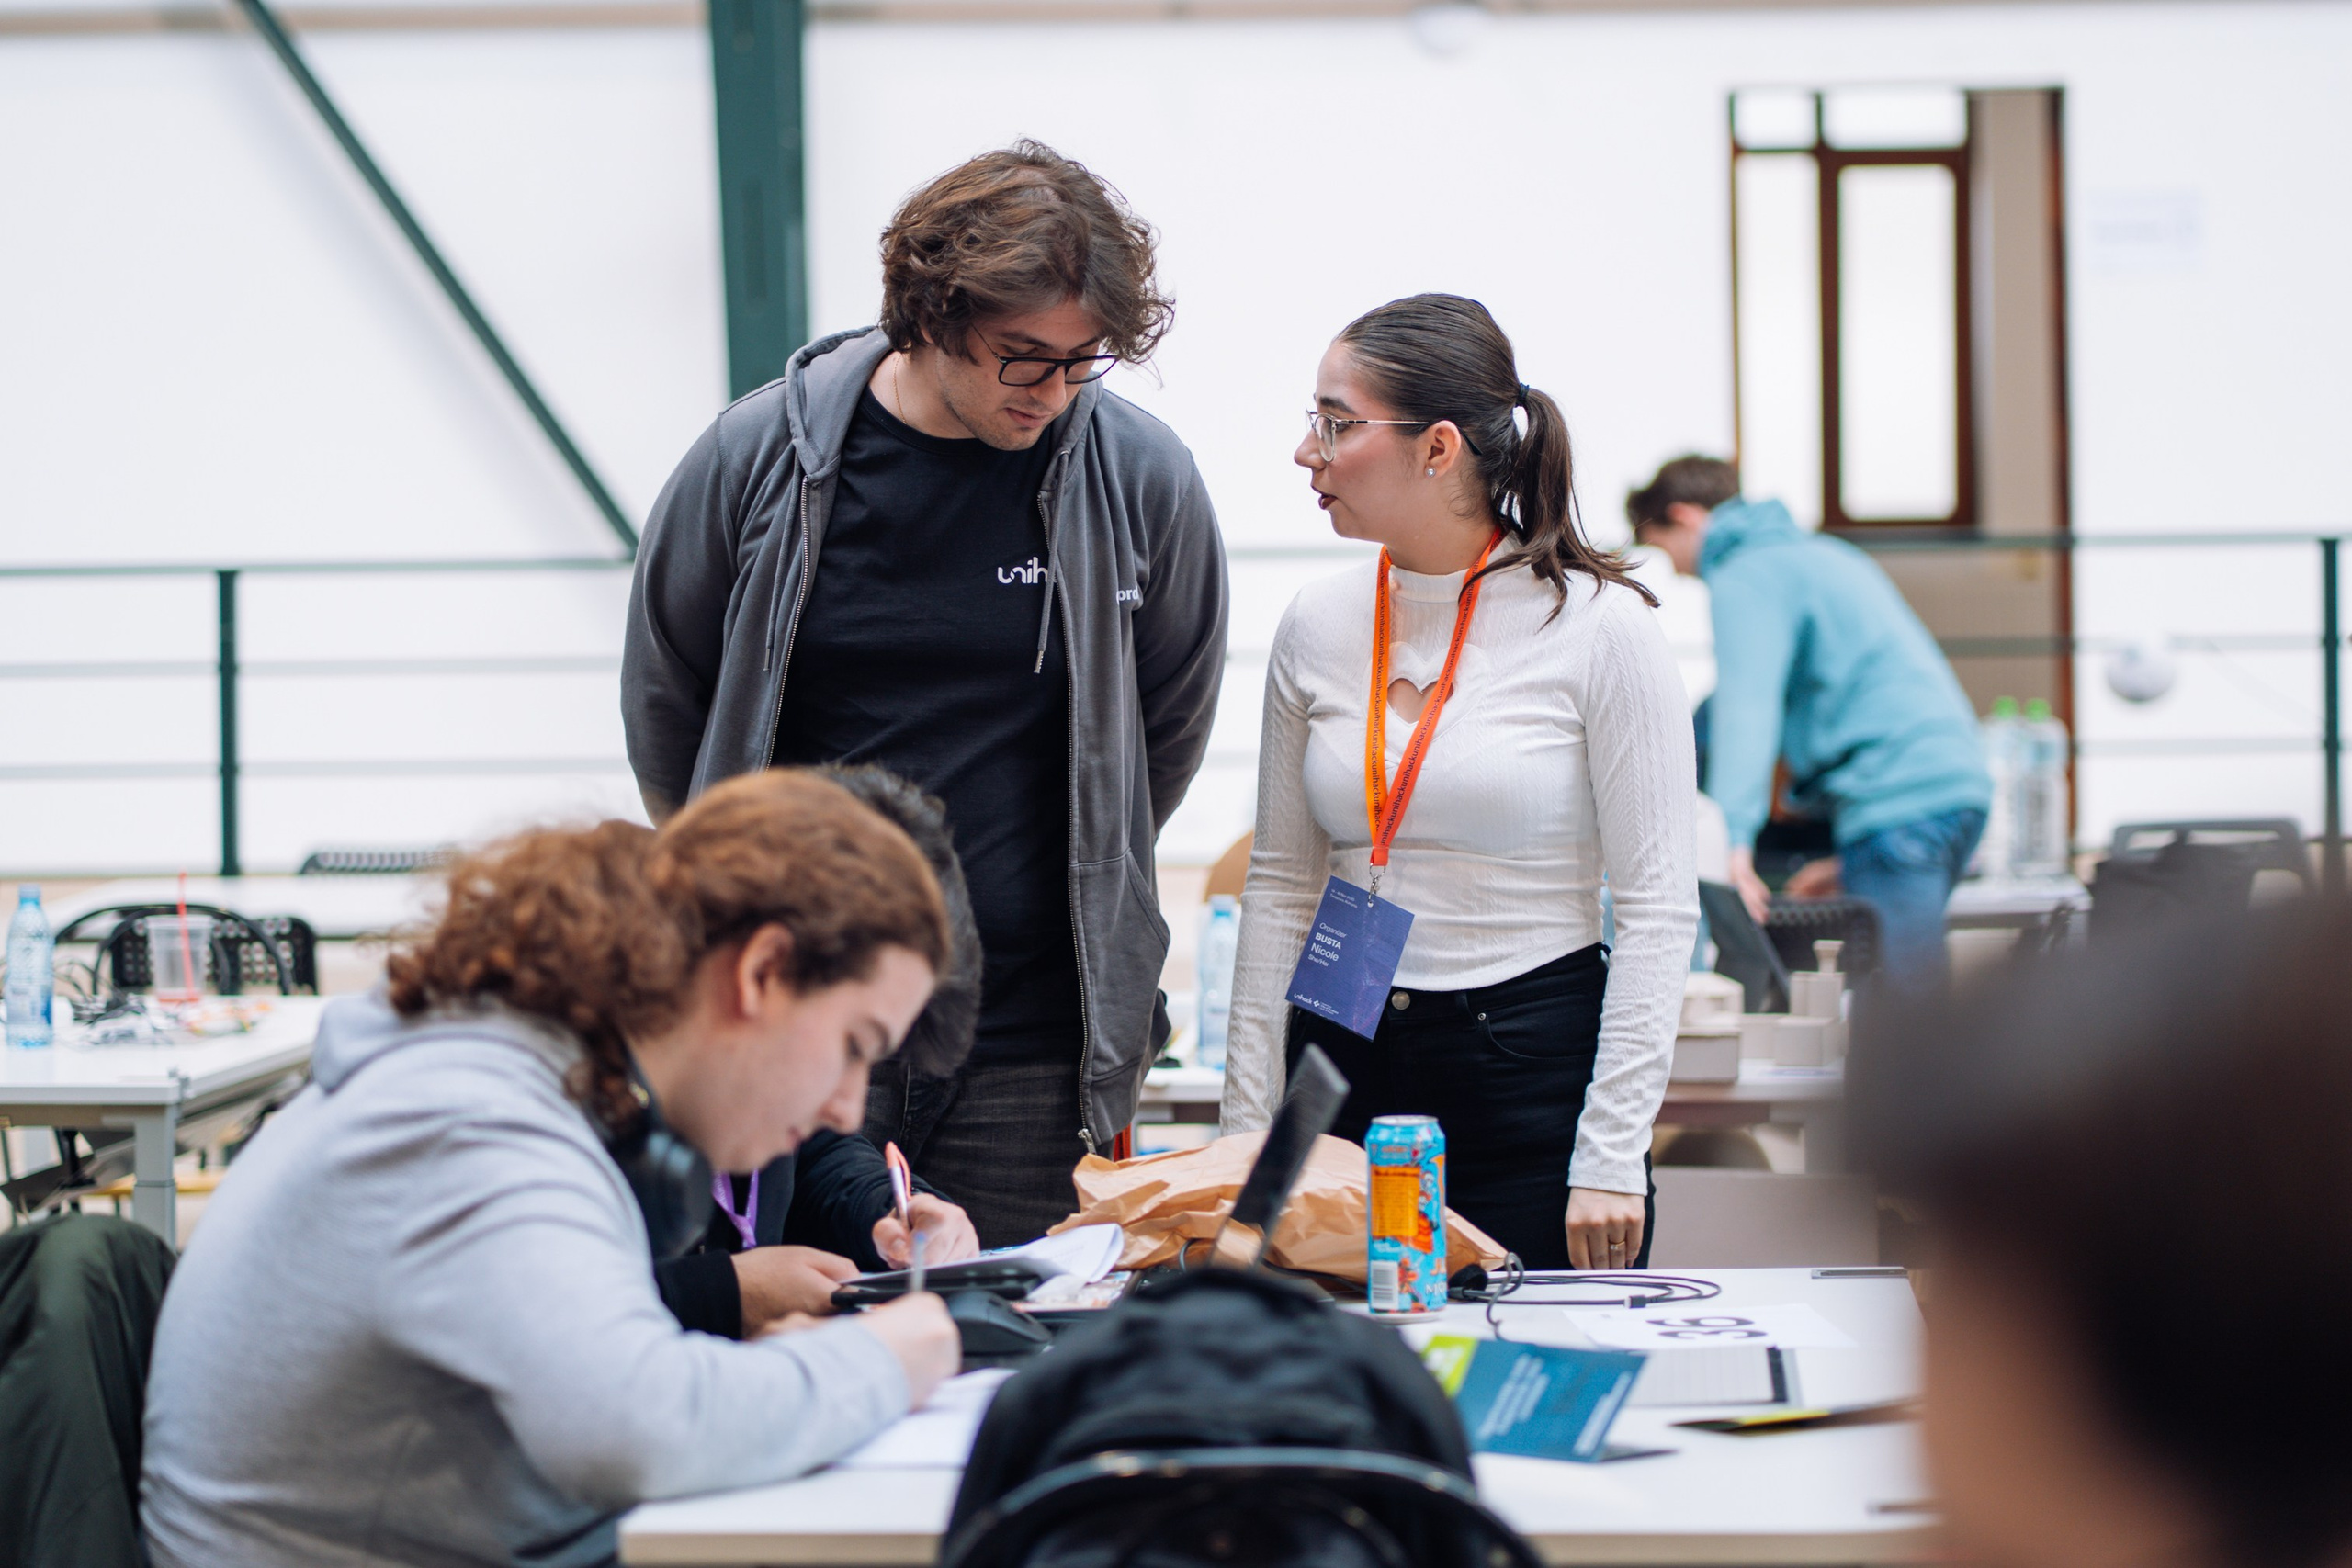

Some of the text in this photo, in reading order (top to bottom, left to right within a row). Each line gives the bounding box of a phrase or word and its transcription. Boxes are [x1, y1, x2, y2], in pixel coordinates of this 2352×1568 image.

[1319, 922, 1347, 938] Organizer
[1315, 932, 1341, 950] BUSTA
[1310, 942, 1340, 962] Nicole
